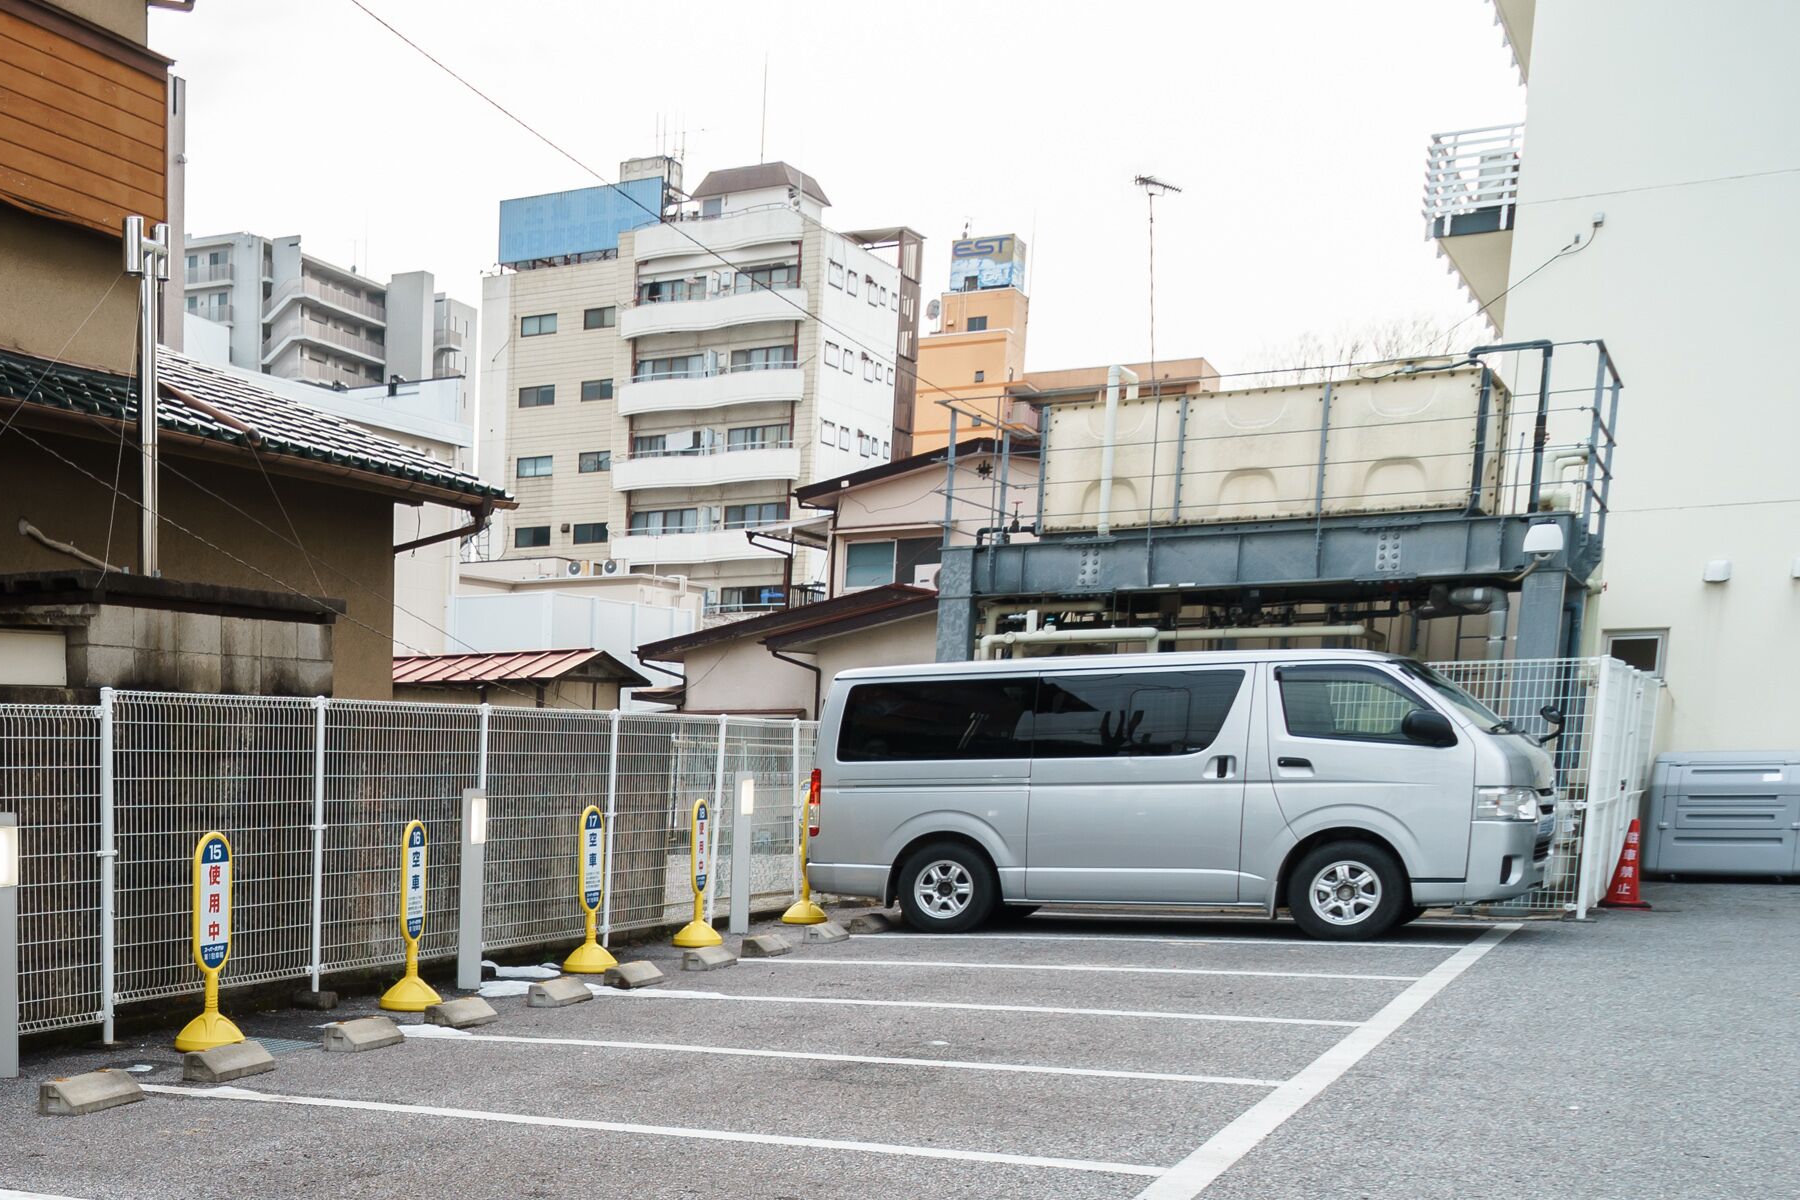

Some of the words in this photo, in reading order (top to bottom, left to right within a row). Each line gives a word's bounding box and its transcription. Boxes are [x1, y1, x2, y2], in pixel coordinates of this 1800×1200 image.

[589, 815, 598, 827] 17
[412, 831, 421, 846] 16
[589, 832, 597, 867] 空車
[209, 844, 222, 860] 15
[411, 850, 421, 891] 空車
[208, 865, 221, 941] 使用中
